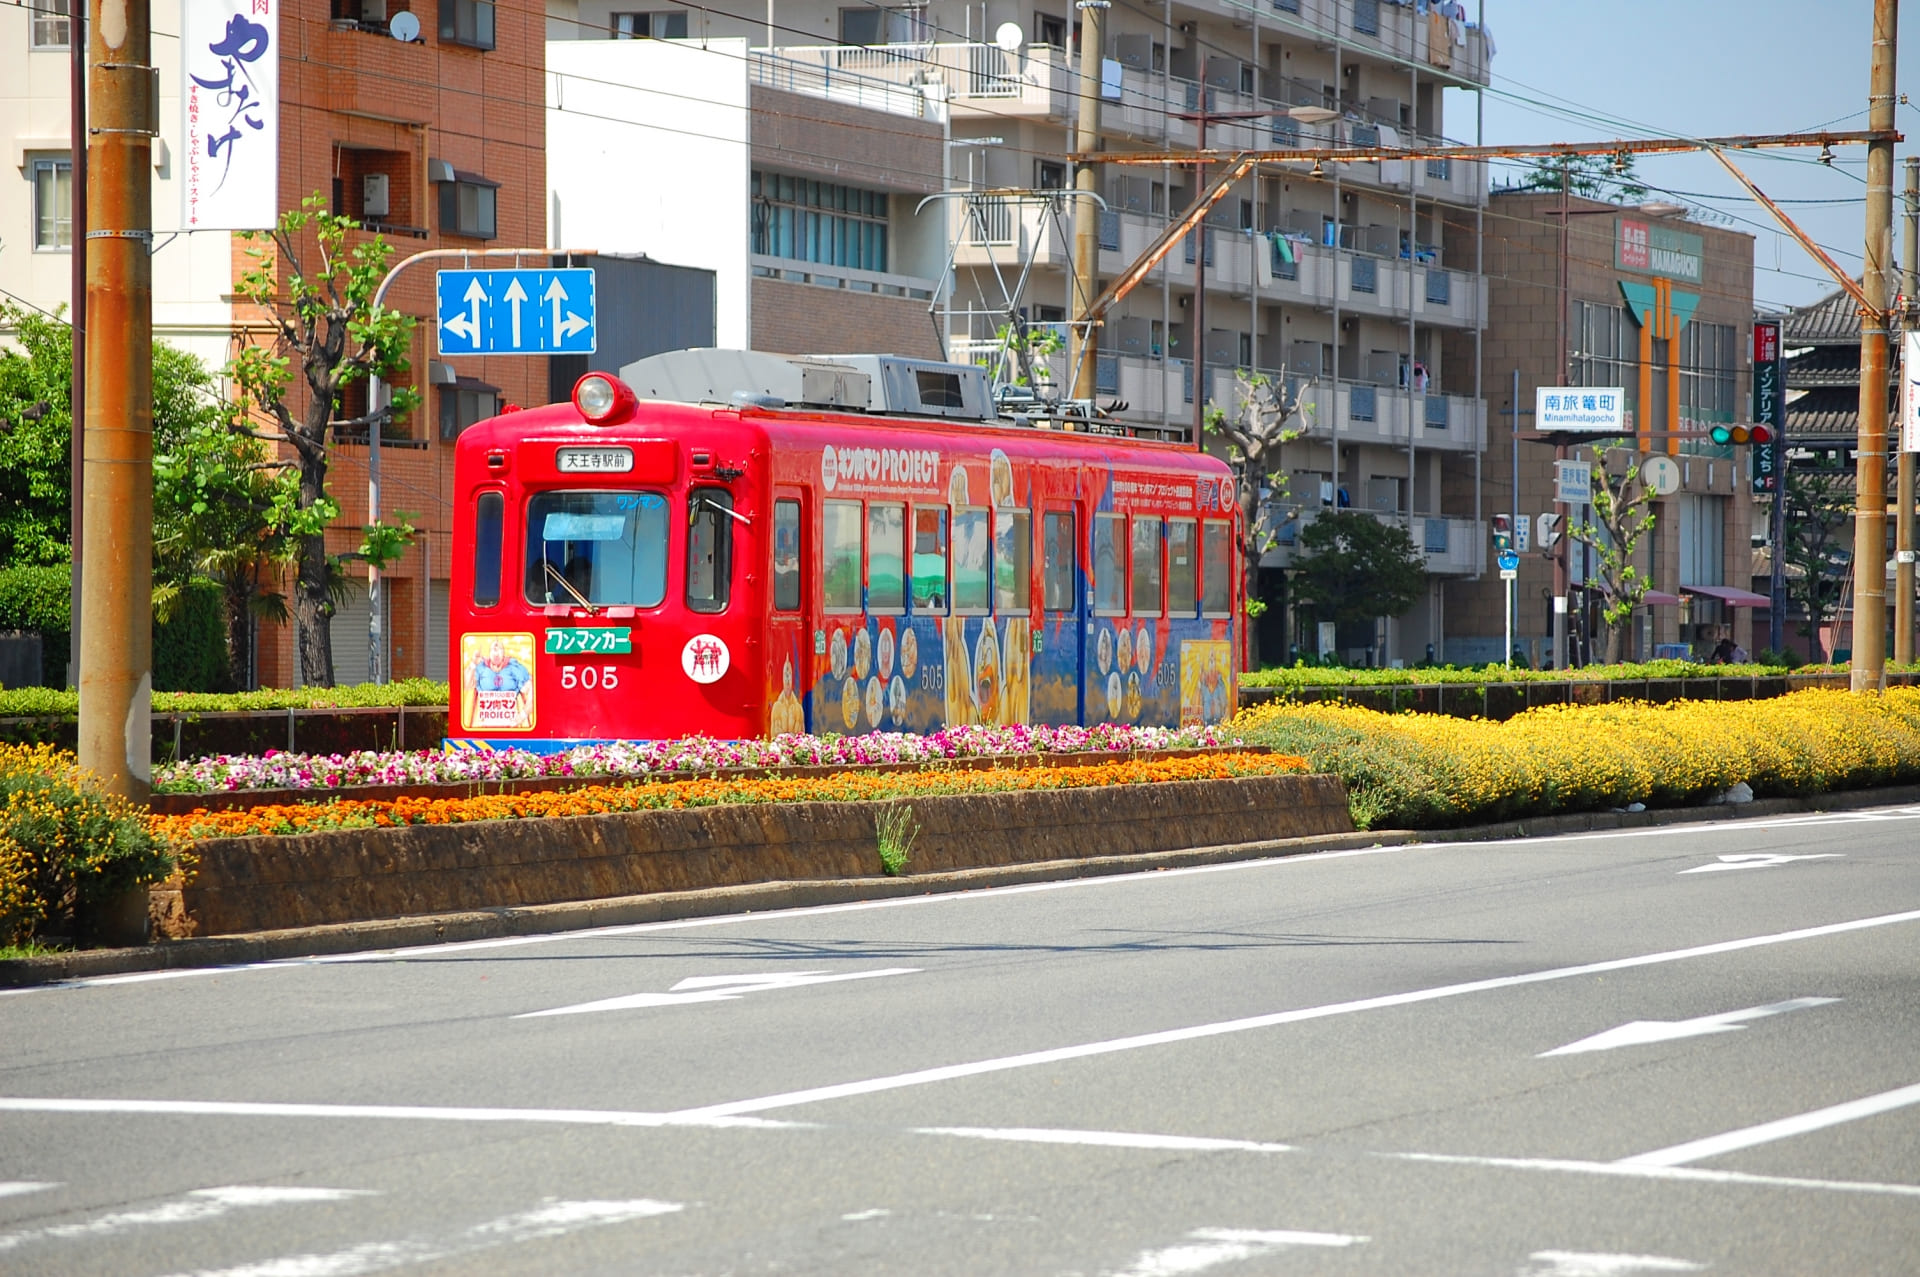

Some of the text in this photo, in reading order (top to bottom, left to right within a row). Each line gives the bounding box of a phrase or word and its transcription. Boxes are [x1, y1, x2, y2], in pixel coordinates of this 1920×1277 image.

[189, 13, 269, 198] やまたけ
[1544, 413, 1615, 423] Minamihatagocho
[567, 453, 625, 468] 天王寺駅前
[881, 448, 939, 483] PROJECT
[617, 495, 664, 510] ワンマン
[549, 631, 628, 650] ワンマンカー
[561, 666, 619, 690] 505
[921, 665, 943, 690] 505
[479, 711, 515, 719] PROJECT
